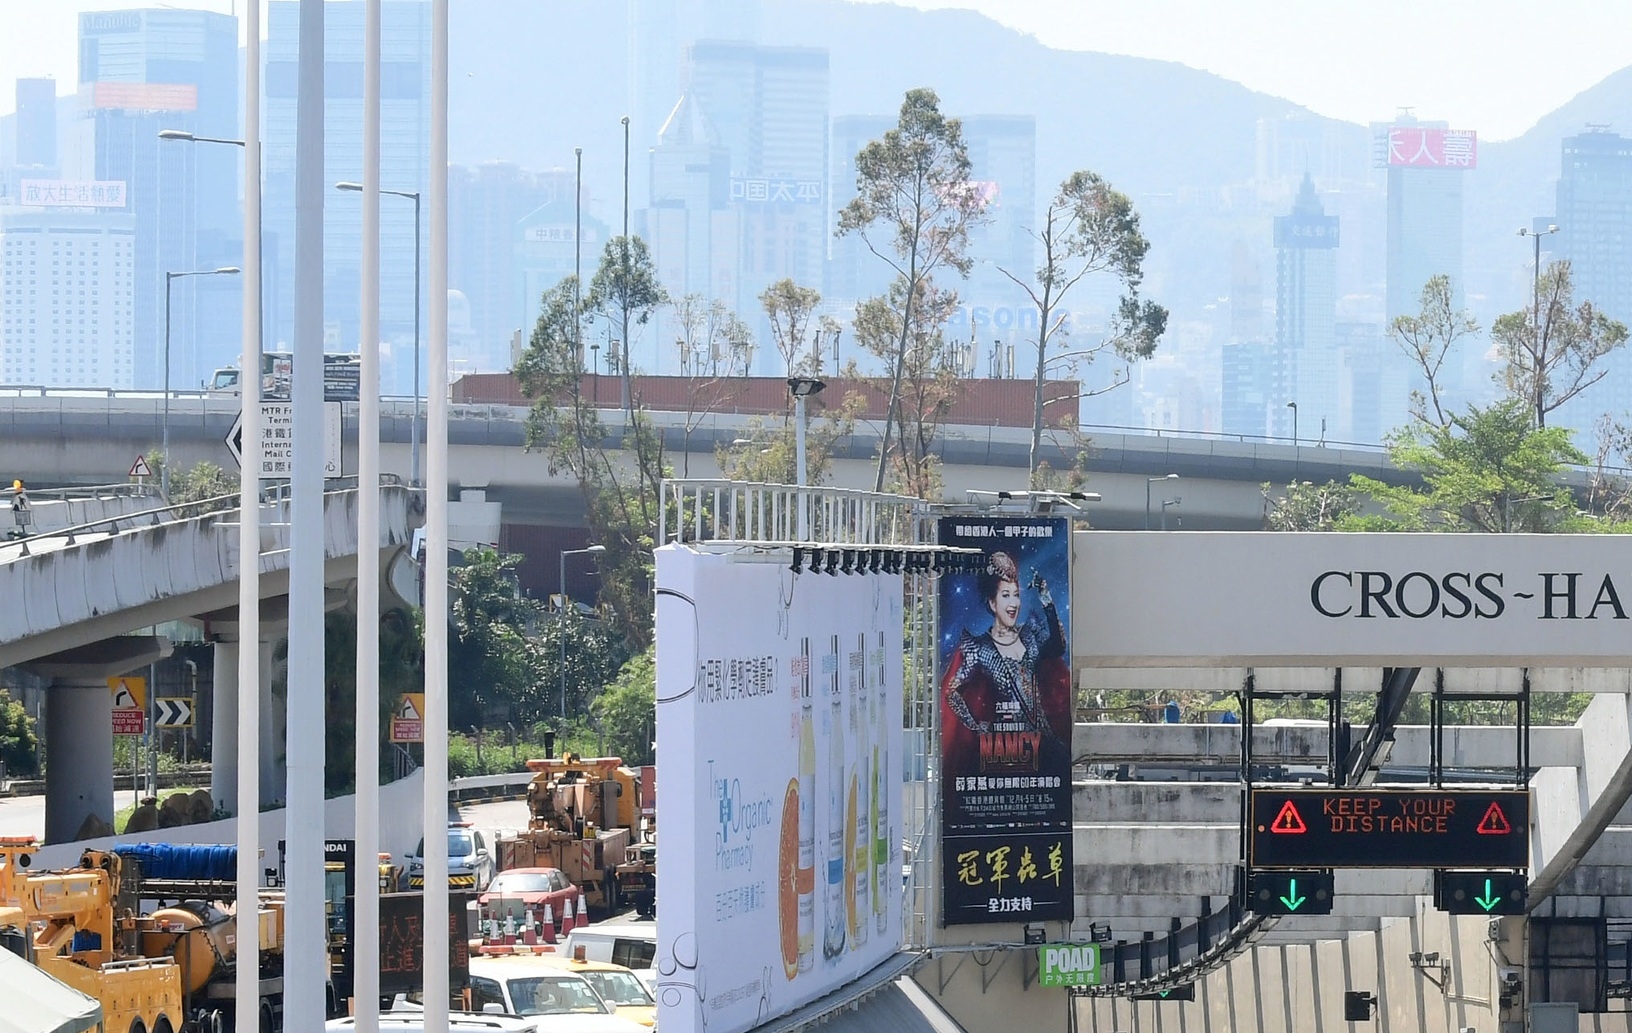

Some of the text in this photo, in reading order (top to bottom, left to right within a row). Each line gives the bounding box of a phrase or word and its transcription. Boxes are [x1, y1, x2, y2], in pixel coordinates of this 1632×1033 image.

[261, 407, 281, 415] MTR
[268, 416, 292, 424] Termi
[264, 450, 283, 458] Mail
[112, 725, 140, 733] 始減速
[979, 732, 1041, 771] NANCY
[707, 759, 724, 800] The
[731, 776, 772, 842] Organic
[1323, 798, 1456, 815] KEEP YOUR
[1330, 815, 1448, 833] DISTANCE
[324, 843, 347, 852] NDAI
[716, 831, 754, 872] Pharmacy
[988, 896, 1032, 913] 全力支持
[1045, 947, 1095, 973] POAD
